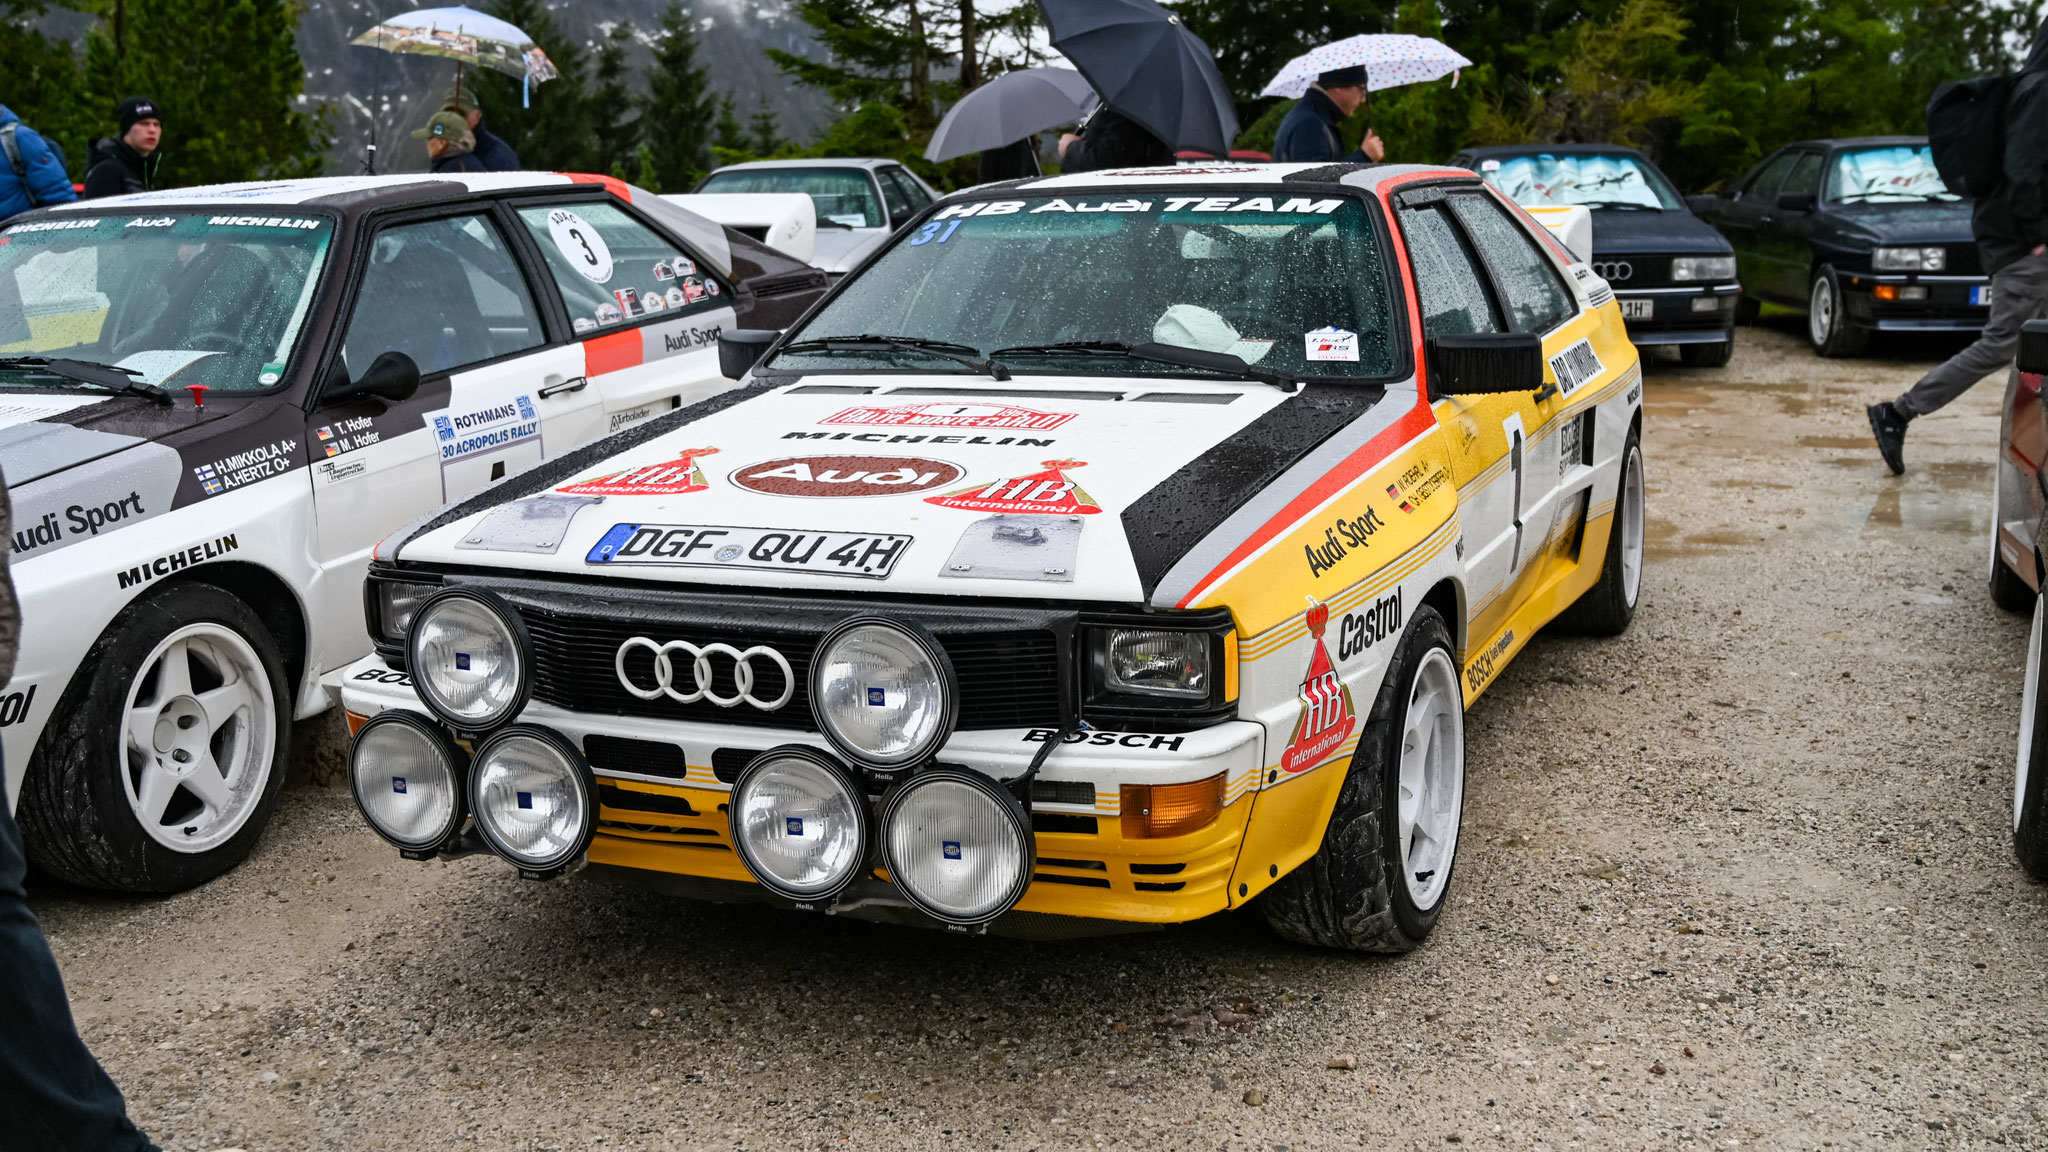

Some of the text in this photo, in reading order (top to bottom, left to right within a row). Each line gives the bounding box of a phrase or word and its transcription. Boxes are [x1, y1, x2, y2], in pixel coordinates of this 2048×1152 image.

[551, 211, 577, 225] ADAC
[933, 197, 1345, 221] HB Audi TEAM
[7, 215, 320, 236] MICHELIN Audi MICHELIN
[910, 219, 962, 247] 31
[569, 228, 599, 266] 3
[665, 324, 722, 352] Audi Sport
[1551, 356, 1574, 394] BAD
[454, 404, 516, 430] ROTHMANS
[617, 409, 651, 425] Turbolader
[841, 409, 1059, 430] RALLYE MONTE-CARLO
[952, 407, 968, 415] 1
[334, 416, 373, 435] T. Hofer
[339, 431, 380, 453] M. Hofer
[442, 422, 537, 458] 30 ACROPOLIS RALLY
[780, 431, 1057, 448] MICHELIN
[215, 439, 297, 476] H.MIKKOLA A+
[223, 461, 275, 490] A.HERTZ
[604, 465, 700, 485] HB
[748, 462, 940, 486] Audi
[569, 484, 688, 495] international
[975, 477, 1079, 503] HB
[1510, 429, 1523, 575] 1
[65, 491, 145, 536] Sport
[941, 498, 1078, 515] international
[600, 544, 613, 554] D
[616, 528, 905, 571] DGF QU 4H
[1304, 505, 1385, 579] Audi Sport
[116, 533, 239, 590] MICHELIN
[1338, 585, 1402, 662] Castrol
[1466, 650, 1495, 693] BOSCH
[1298, 669, 1344, 742] HB
[1021, 728, 1186, 752] BOSCH
[1289, 727, 1346, 769] international
[875, 773, 893, 781] Hella
[796, 902, 814, 911] Hella
[948, 924, 968, 932] Hella
